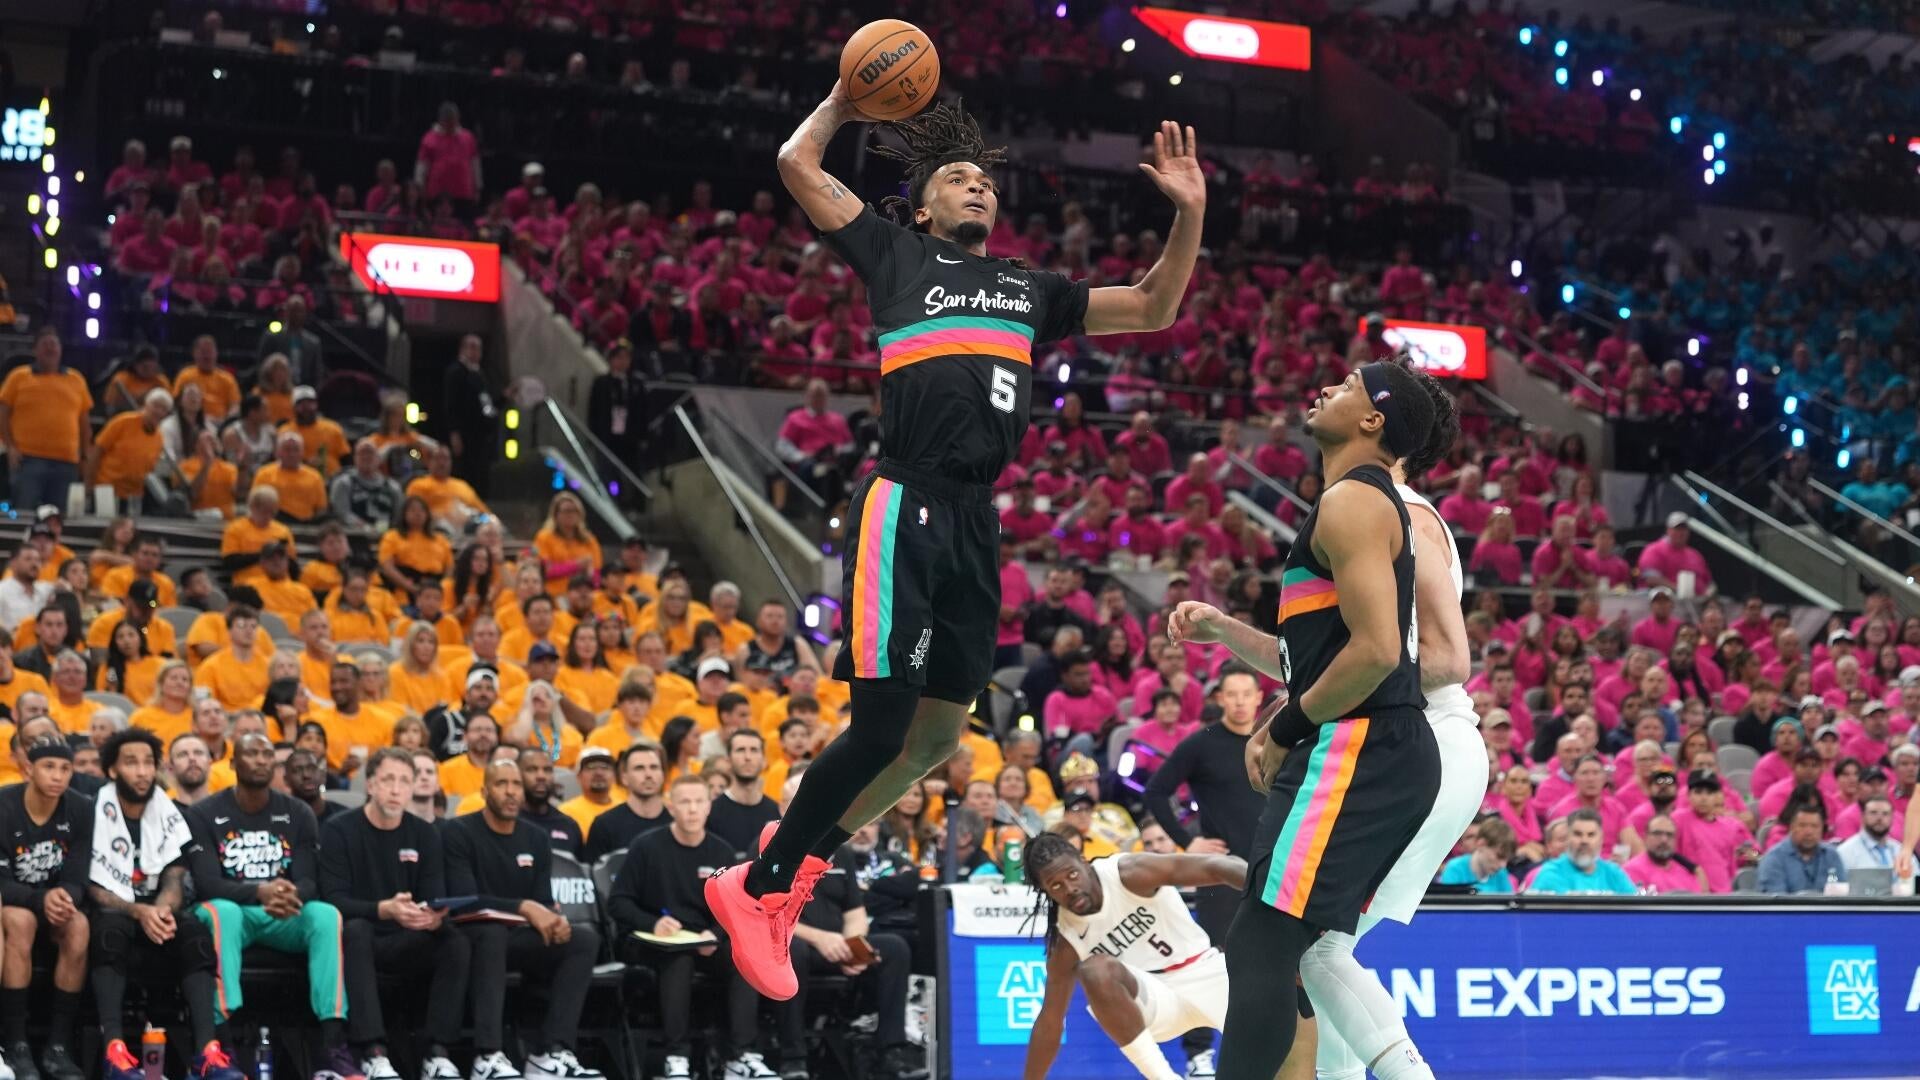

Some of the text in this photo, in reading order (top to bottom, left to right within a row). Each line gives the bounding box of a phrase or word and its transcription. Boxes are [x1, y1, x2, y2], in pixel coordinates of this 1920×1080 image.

[858, 39, 919, 85] Wilson
[924, 285, 1032, 316] San Antonio
[990, 364, 1018, 414] 5
[223, 838, 284, 872] Spurs
[974, 906, 1048, 918] GATORA
[1148, 933, 1173, 957] 5
[1365, 967, 1726, 1018] N EXPRESS
